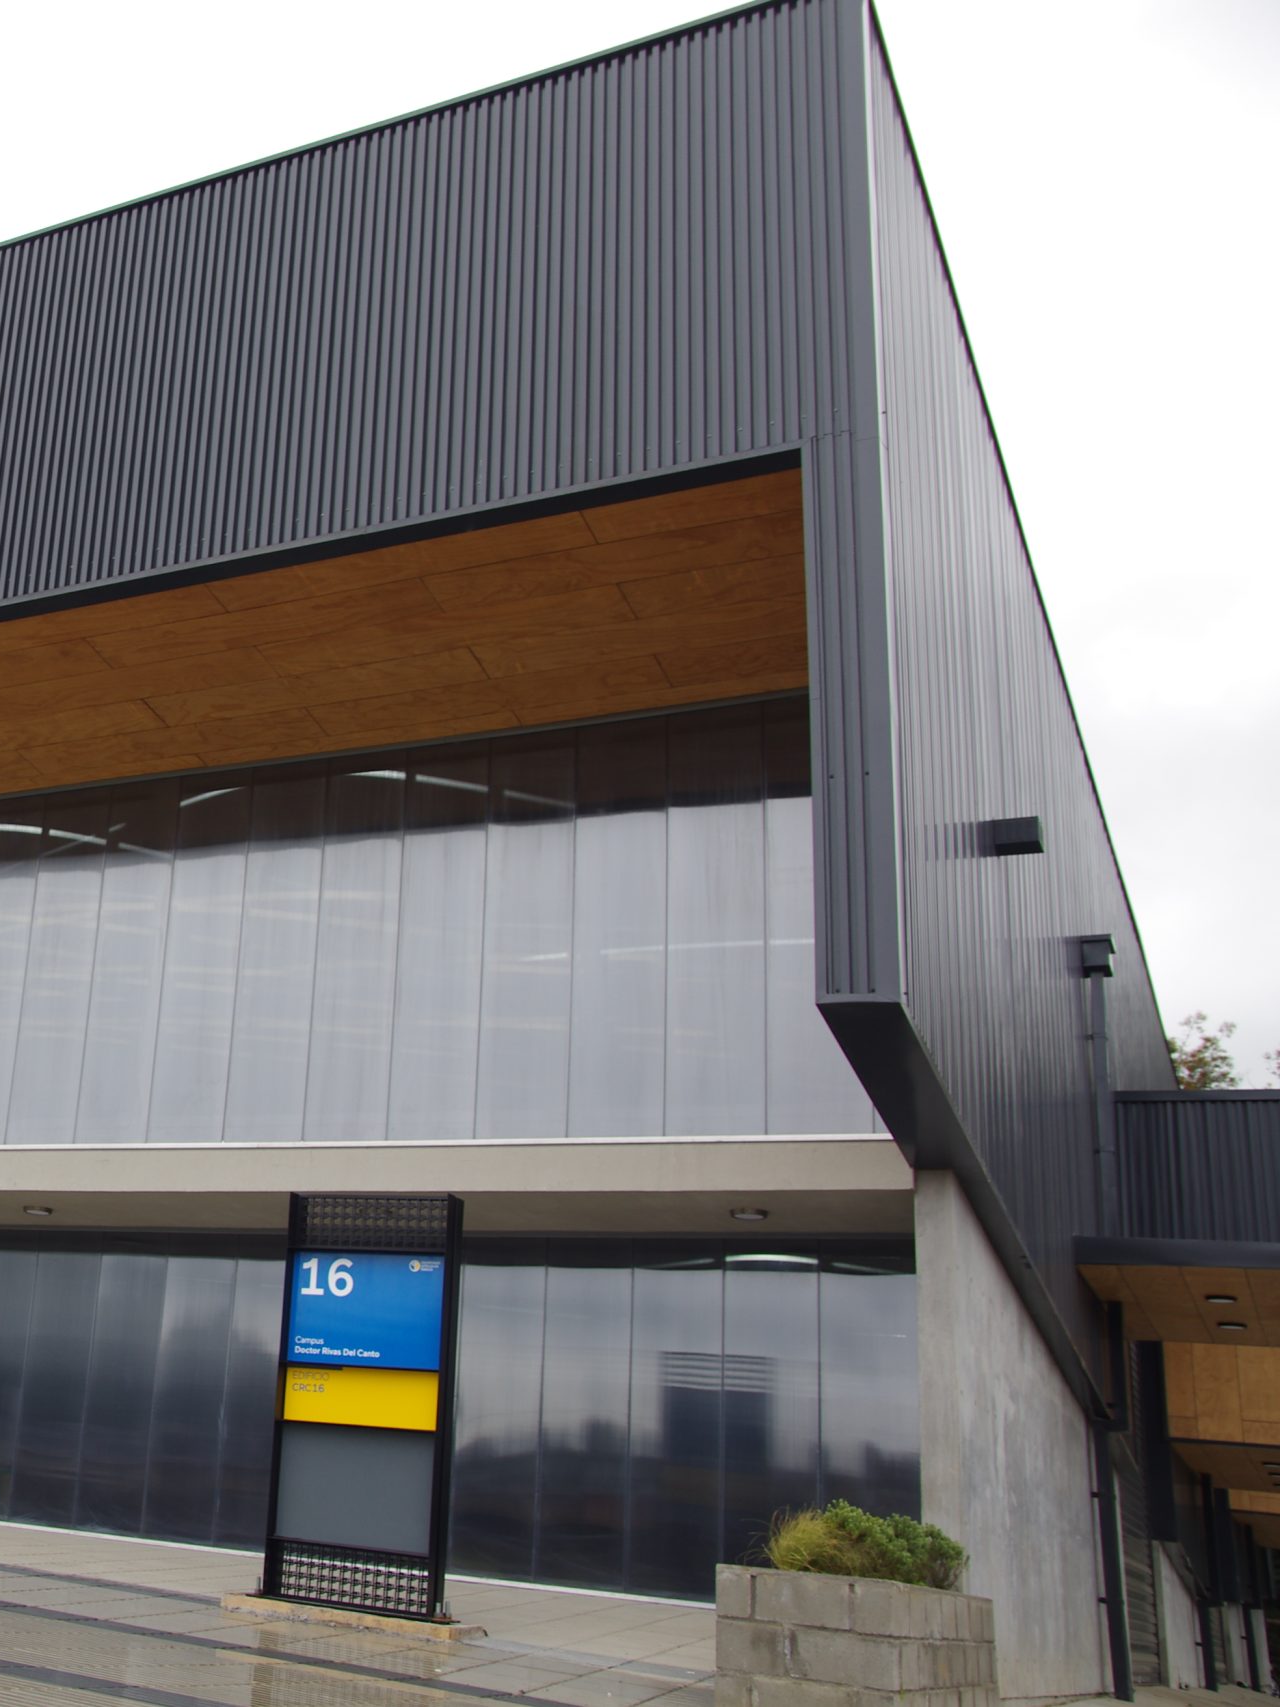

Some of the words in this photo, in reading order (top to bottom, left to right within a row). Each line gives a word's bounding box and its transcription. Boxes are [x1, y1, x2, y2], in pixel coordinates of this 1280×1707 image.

[301, 1257, 354, 1297] 16
[295, 1336, 324, 1345] Campus
[294, 1346, 321, 1355] Doctor
[322, 1347, 341, 1356] Rivas
[343, 1348, 356, 1357] Del
[357, 1349, 380, 1358] Canto
